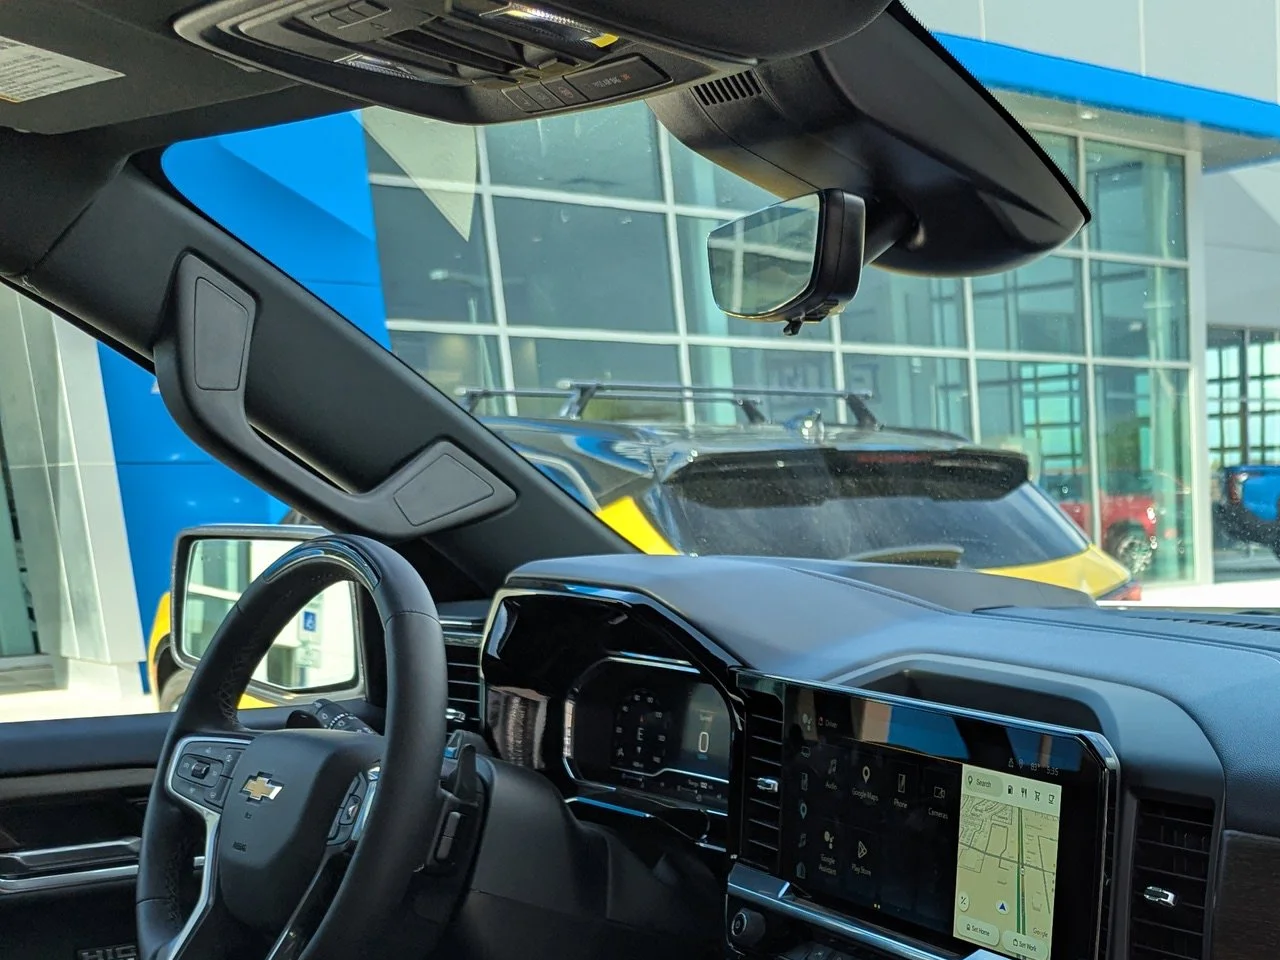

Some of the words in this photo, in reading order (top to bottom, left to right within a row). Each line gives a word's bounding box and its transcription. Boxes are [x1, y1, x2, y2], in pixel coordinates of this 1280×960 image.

[698, 731, 709, 753] 0
[825, 781, 837, 790] Audio
[976, 778, 991, 788] Search
[852, 787, 867, 800] Google
[867, 790, 879, 801] Maps
[894, 798, 907, 808] Phone
[928, 807, 948, 820] Cameras
[978, 927, 990, 937] Home
[1032, 927, 1048, 938] Google
[1026, 942, 1037, 952] Work
